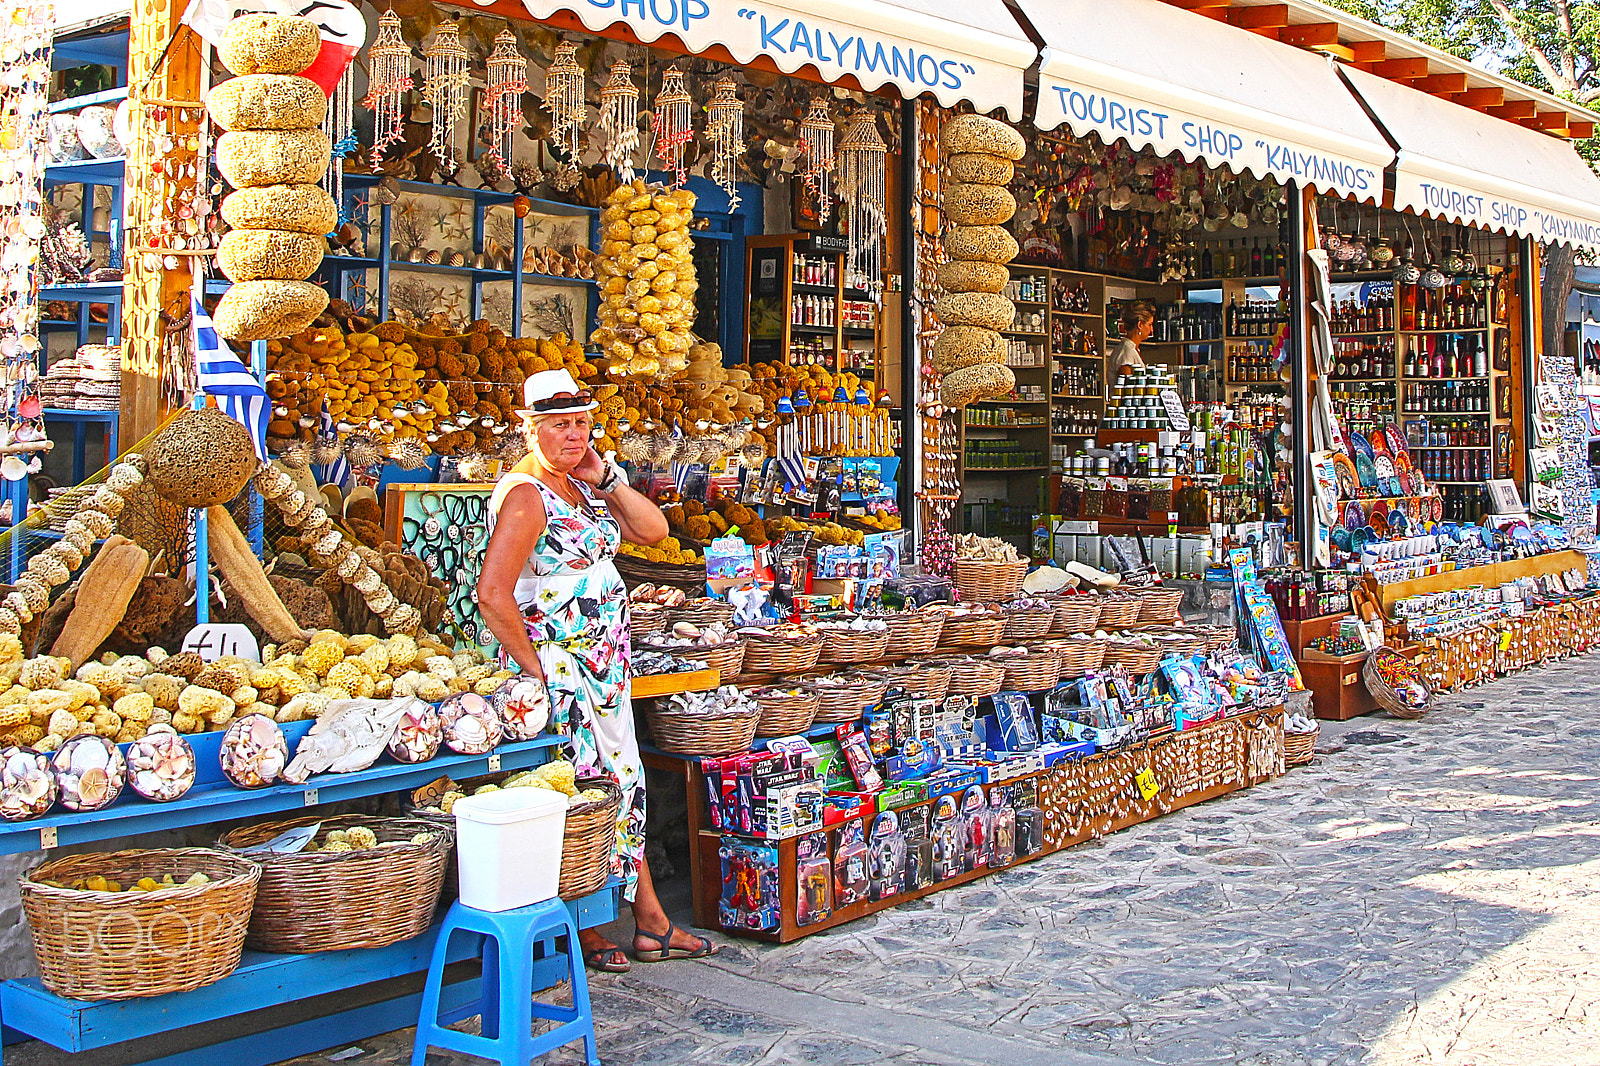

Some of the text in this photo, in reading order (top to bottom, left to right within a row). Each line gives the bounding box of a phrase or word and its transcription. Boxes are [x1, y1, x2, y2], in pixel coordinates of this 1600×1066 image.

[586, 0, 709, 31] HOP
[1051, 85, 1169, 140] TOURIST
[1181, 122, 1243, 159] SHOP
[1419, 183, 1484, 217] TOURIST
[1491, 201, 1528, 228] SHOP
